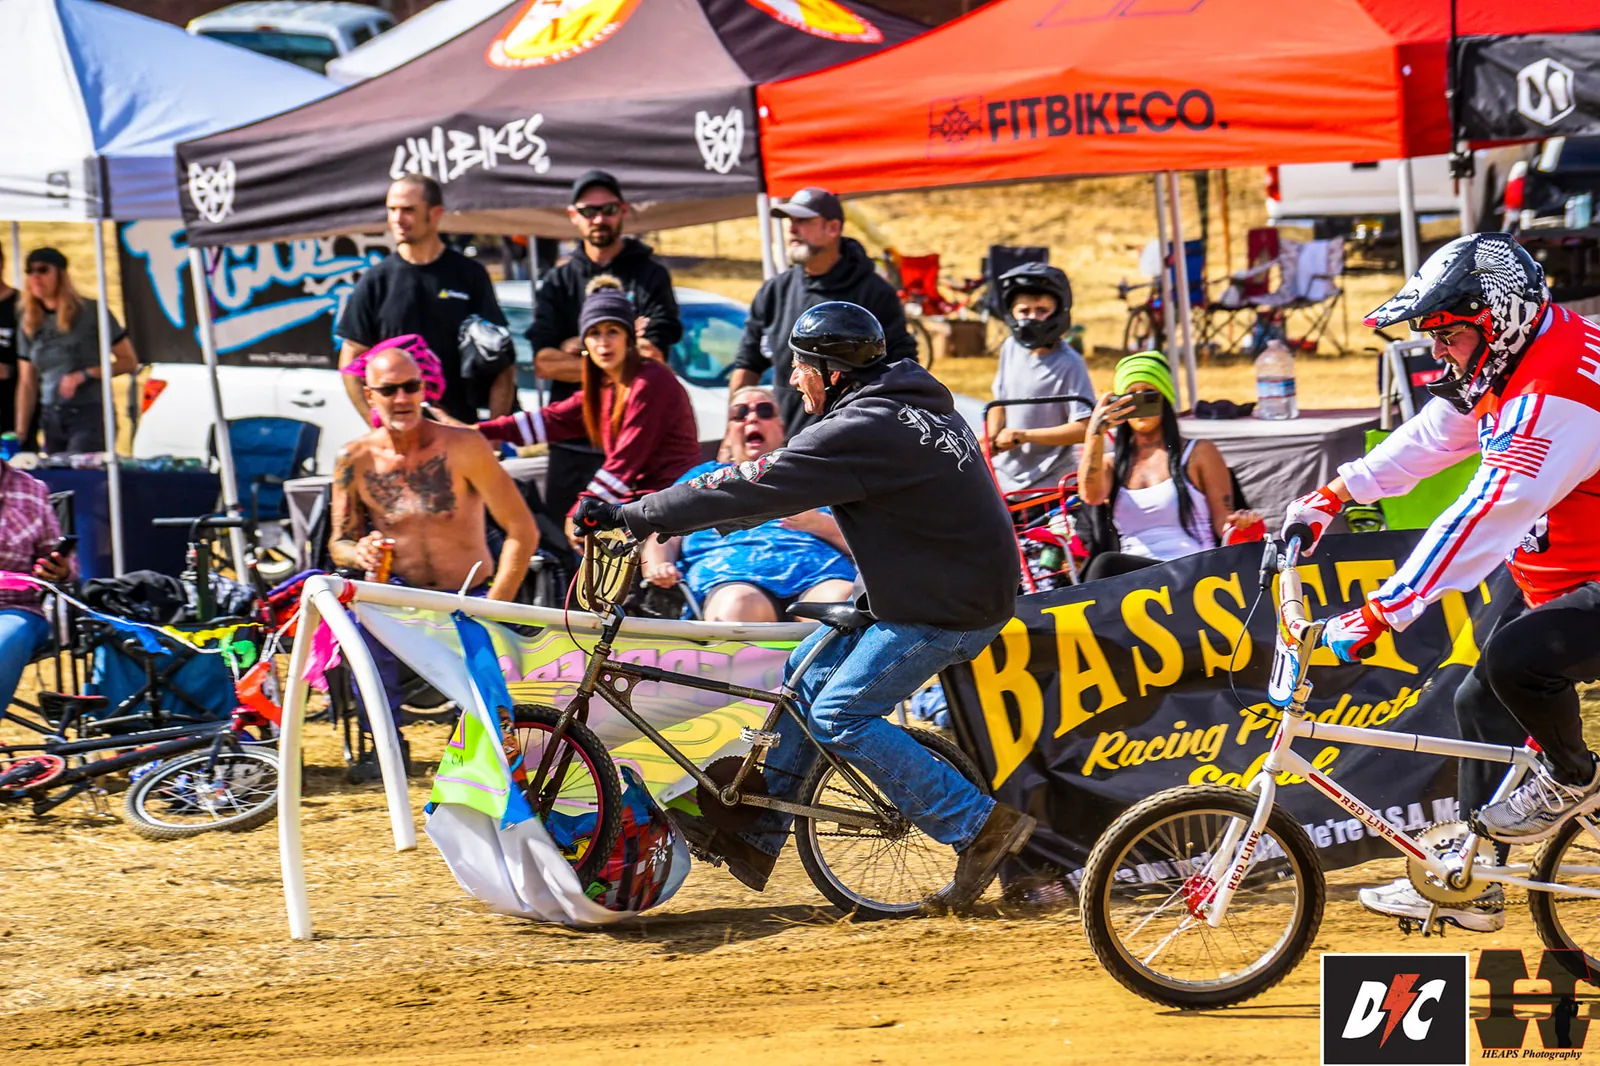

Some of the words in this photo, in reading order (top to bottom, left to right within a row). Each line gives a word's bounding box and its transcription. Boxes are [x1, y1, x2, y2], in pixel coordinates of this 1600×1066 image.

[987, 89, 1229, 142] FITBIKECO.
[1081, 720, 1229, 776] Racing
[1235, 686, 1421, 745] Prducts
[1341, 796, 1365, 816] RED
[1366, 815, 1395, 838] LINE
[1227, 864, 1245, 891] RED
[1240, 830, 1261, 861] LINE
